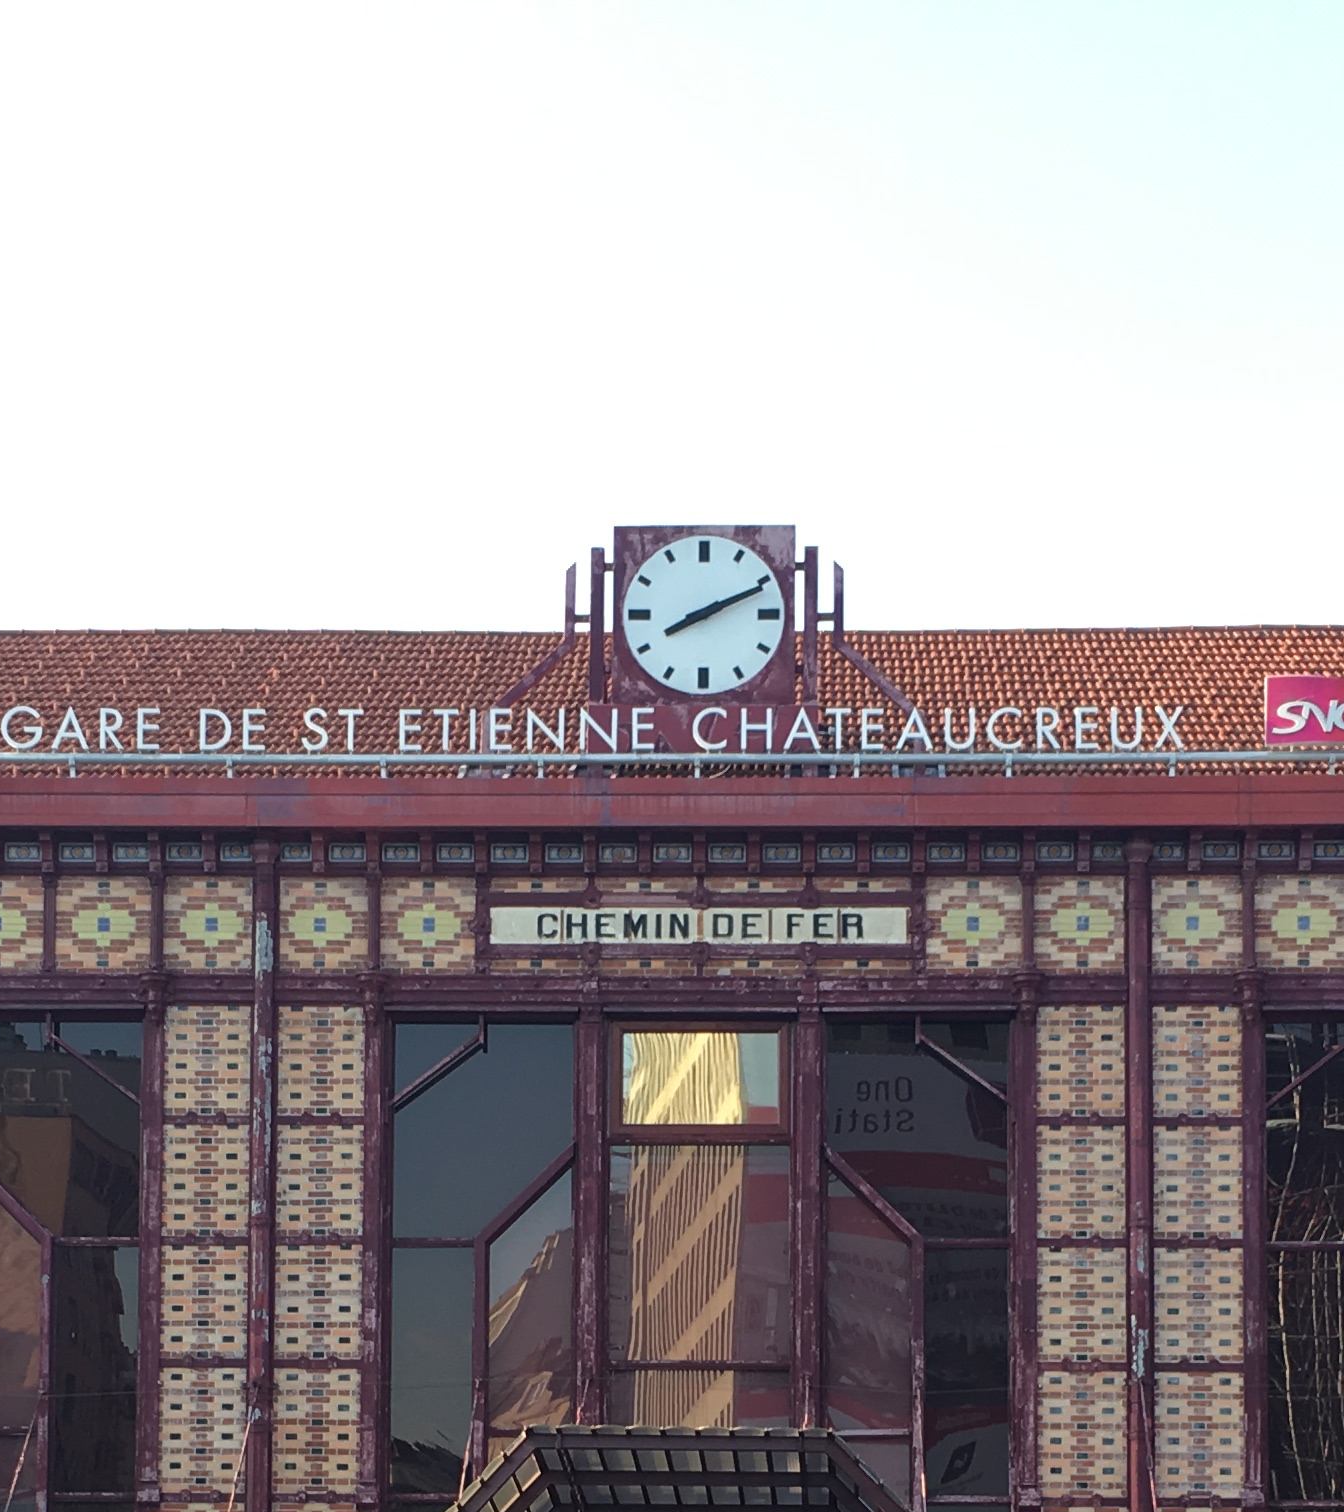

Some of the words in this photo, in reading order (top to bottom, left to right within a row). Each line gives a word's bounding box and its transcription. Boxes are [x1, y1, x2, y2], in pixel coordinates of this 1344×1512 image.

[0, 706, 162, 753] GARE
[198, 707, 267, 753] DE
[301, 707, 365, 753] ST
[398, 707, 655, 752] ETIENNE
[692, 706, 1187, 752] CHATEAUCREUX
[536, 912, 690, 940] CHEMIN
[712, 912, 763, 939] DE
[786, 912, 865, 939] FER
